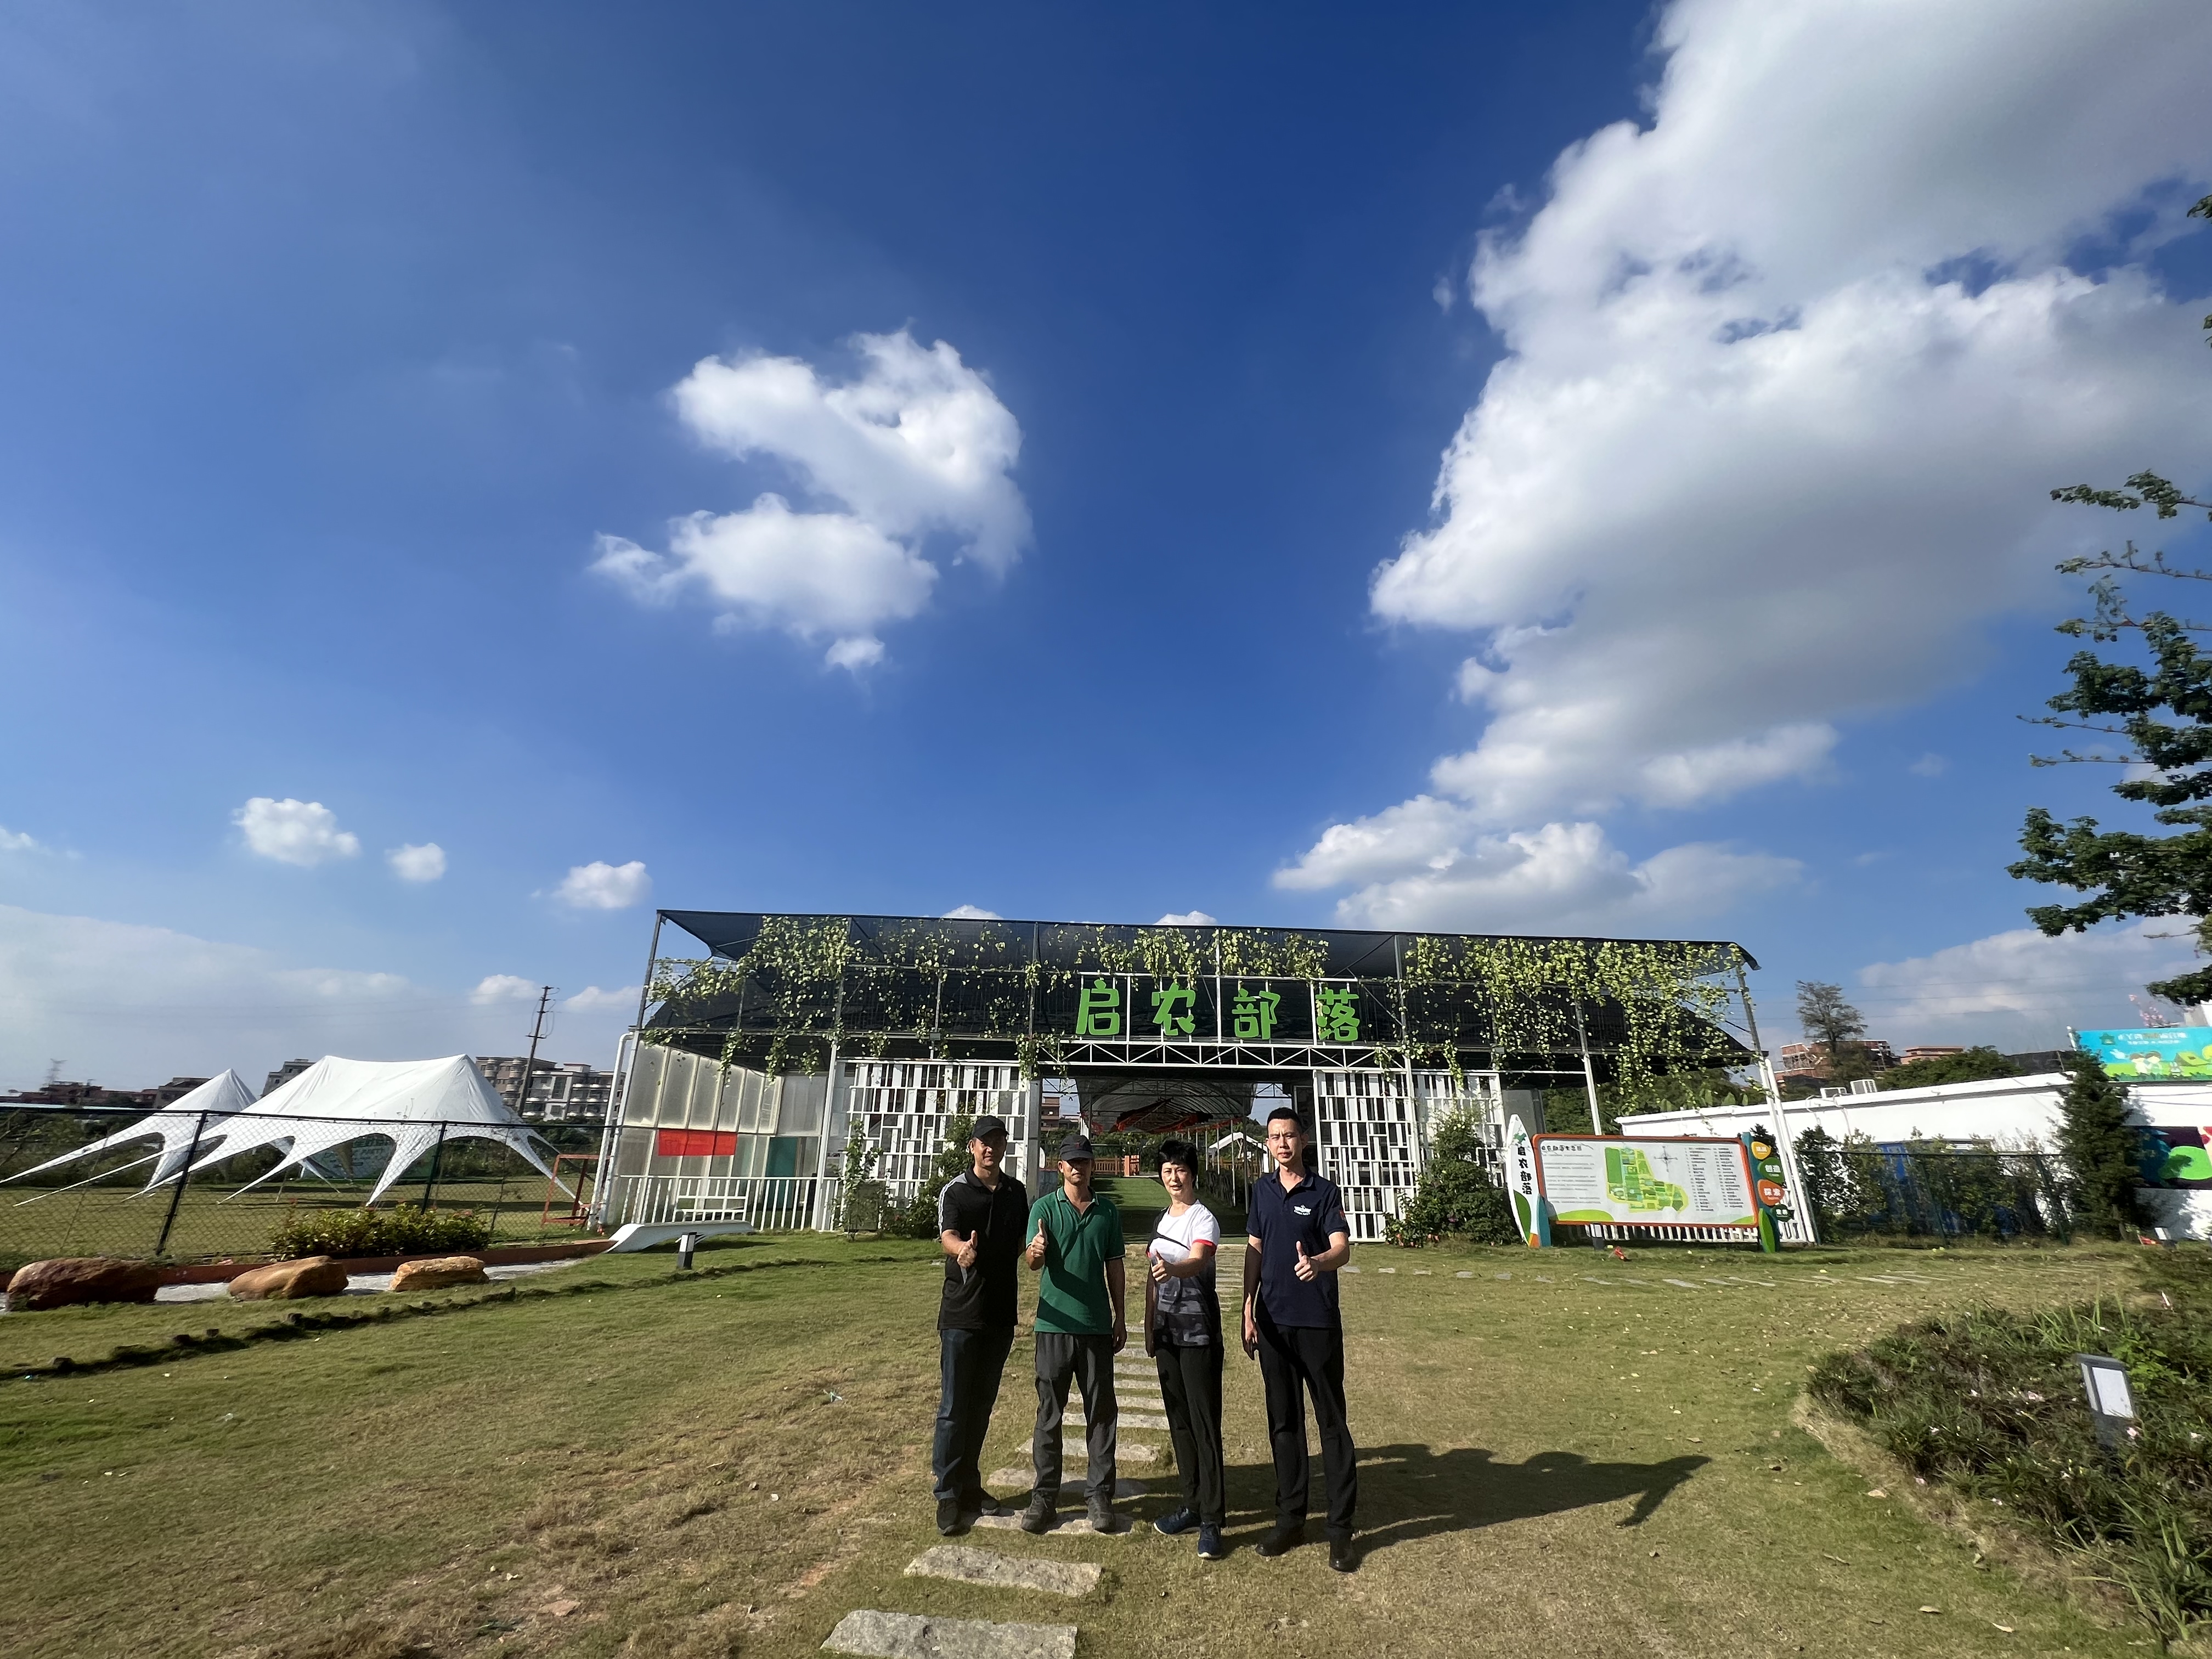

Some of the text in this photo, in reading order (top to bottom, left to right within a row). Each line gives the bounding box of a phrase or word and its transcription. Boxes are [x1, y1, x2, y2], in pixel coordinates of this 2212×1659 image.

[1075, 979, 1360, 1042] 启农部落
[1517, 1146, 1532, 1195] 启农部落
